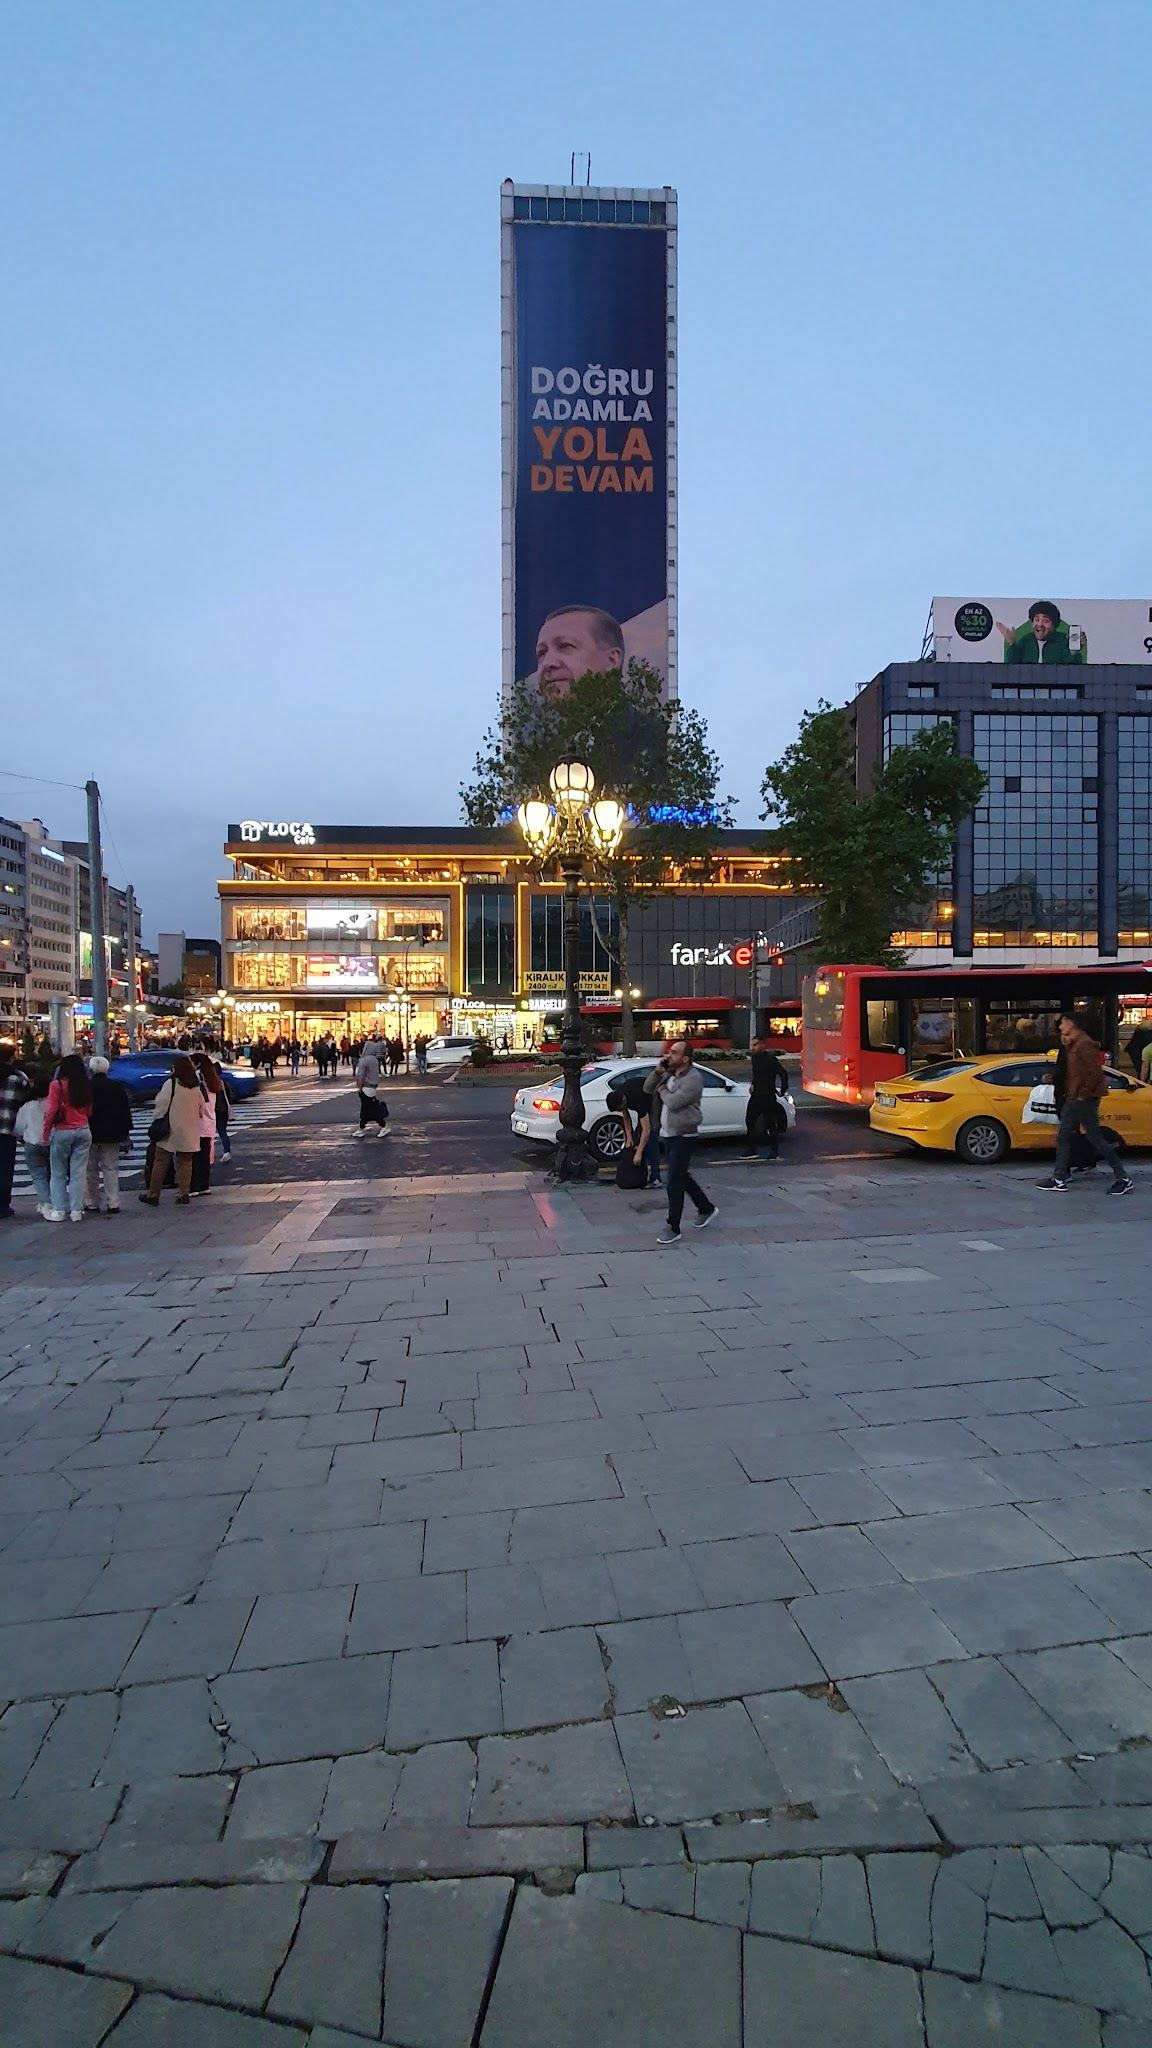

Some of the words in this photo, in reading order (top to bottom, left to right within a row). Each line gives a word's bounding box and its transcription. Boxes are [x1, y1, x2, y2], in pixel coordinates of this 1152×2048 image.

[531, 363, 654, 396] DOĞRU
[531, 398, 653, 421] ADAMLA
[533, 426, 653, 461] YOLA
[530, 464, 654, 493] DEVAM
[960, 615, 988, 626] %30
[528, 982, 547, 990] 2400
